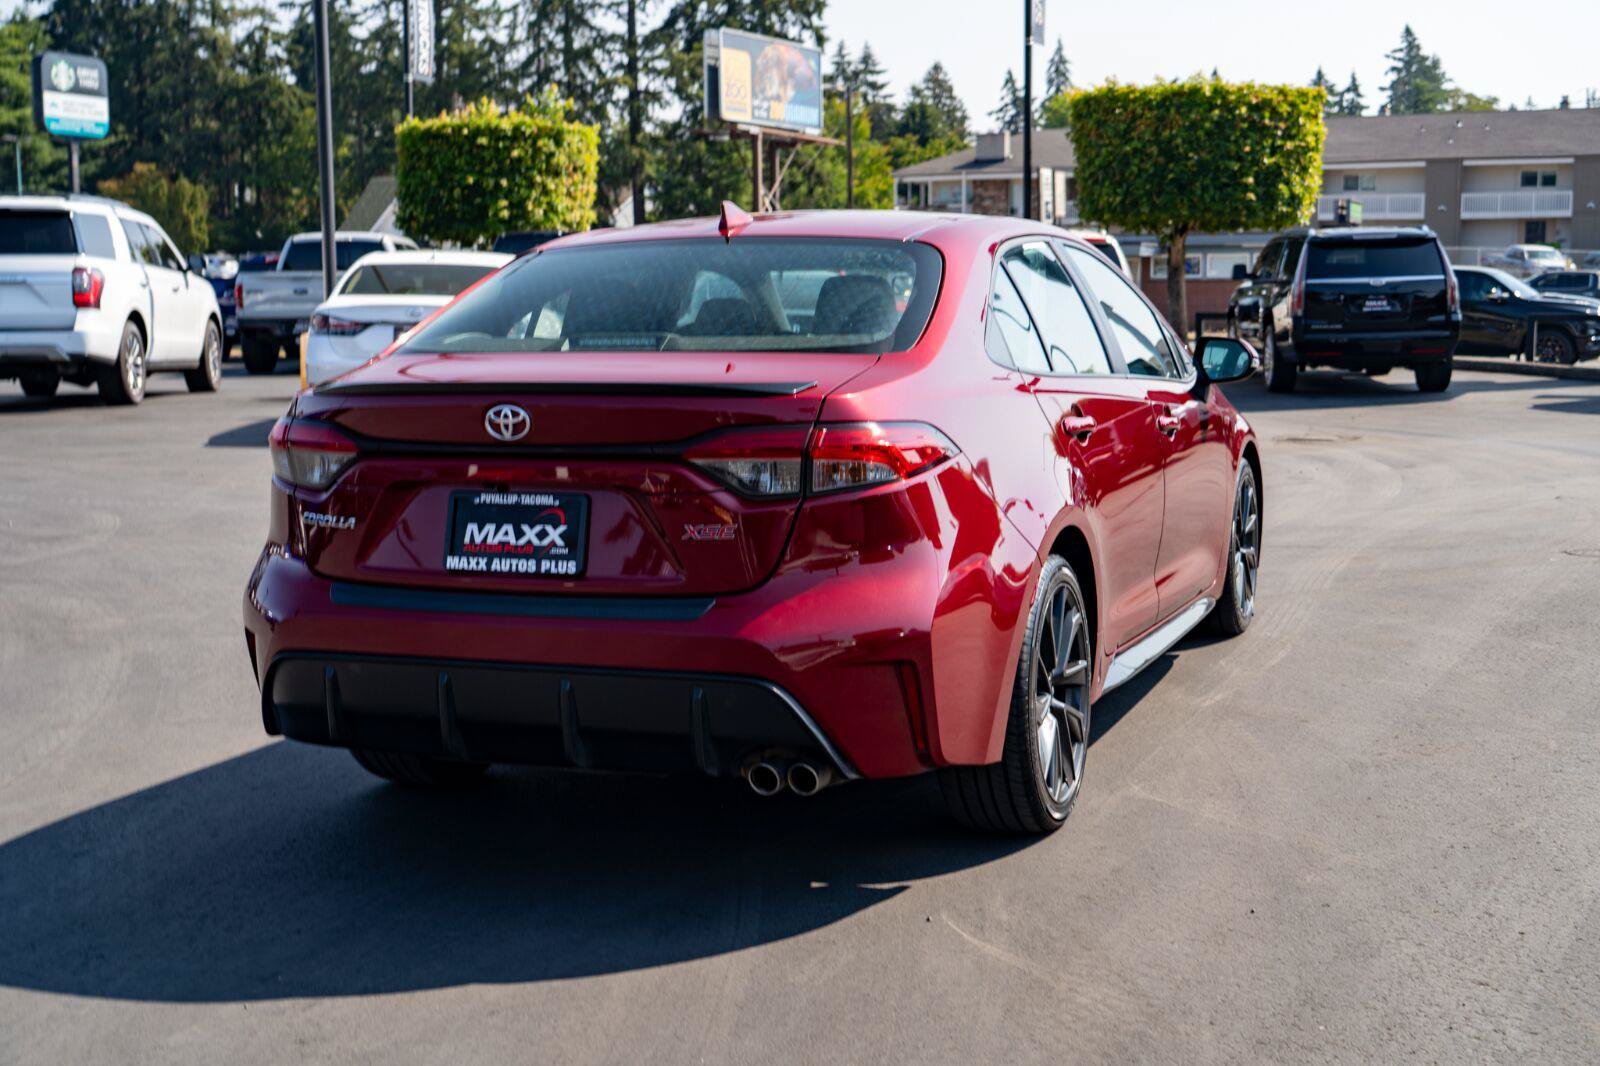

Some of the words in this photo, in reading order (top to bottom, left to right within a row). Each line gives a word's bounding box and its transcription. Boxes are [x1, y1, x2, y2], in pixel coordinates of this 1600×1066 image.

[303, 511, 356, 530] COROLLA
[463, 521, 568, 547] MAXX
[446, 555, 488, 571] MAXX
[491, 557, 537, 573] AUTOS
[540, 559, 577, 575] PLUS
